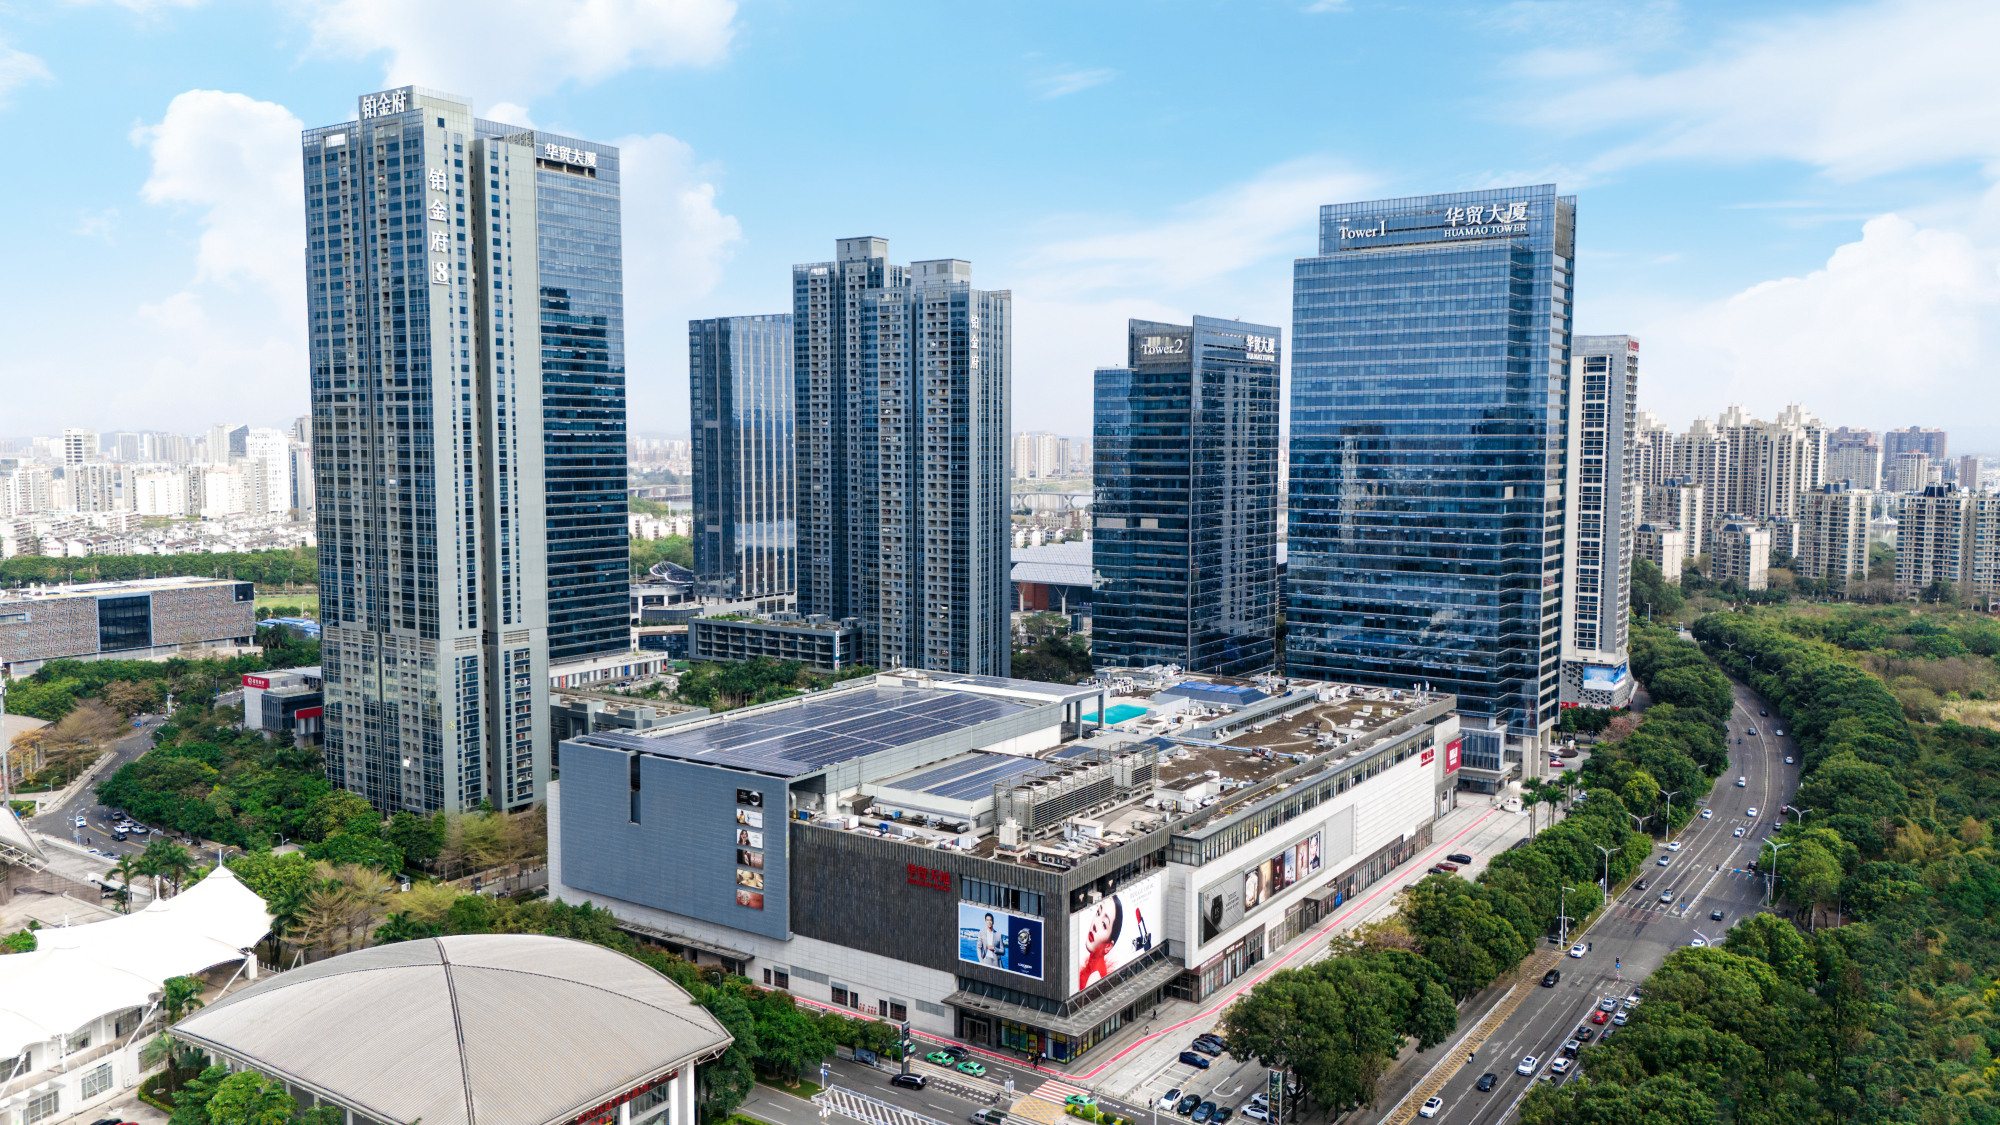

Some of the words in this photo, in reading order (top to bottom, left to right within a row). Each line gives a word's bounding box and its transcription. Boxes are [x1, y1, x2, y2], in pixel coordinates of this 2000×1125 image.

[362, 89, 407, 120] 铂金府
[545, 143, 597, 168] 华贸大厦
[429, 168, 449, 253] 铂金府
[1444, 201, 1529, 227] 华贸大厦
[1444, 226, 1488, 238] HUAMAO
[1491, 223, 1527, 235] TOWER
[1246, 334, 1275, 354] 华贸大厦
[907, 863, 951, 885] 华贸天地
